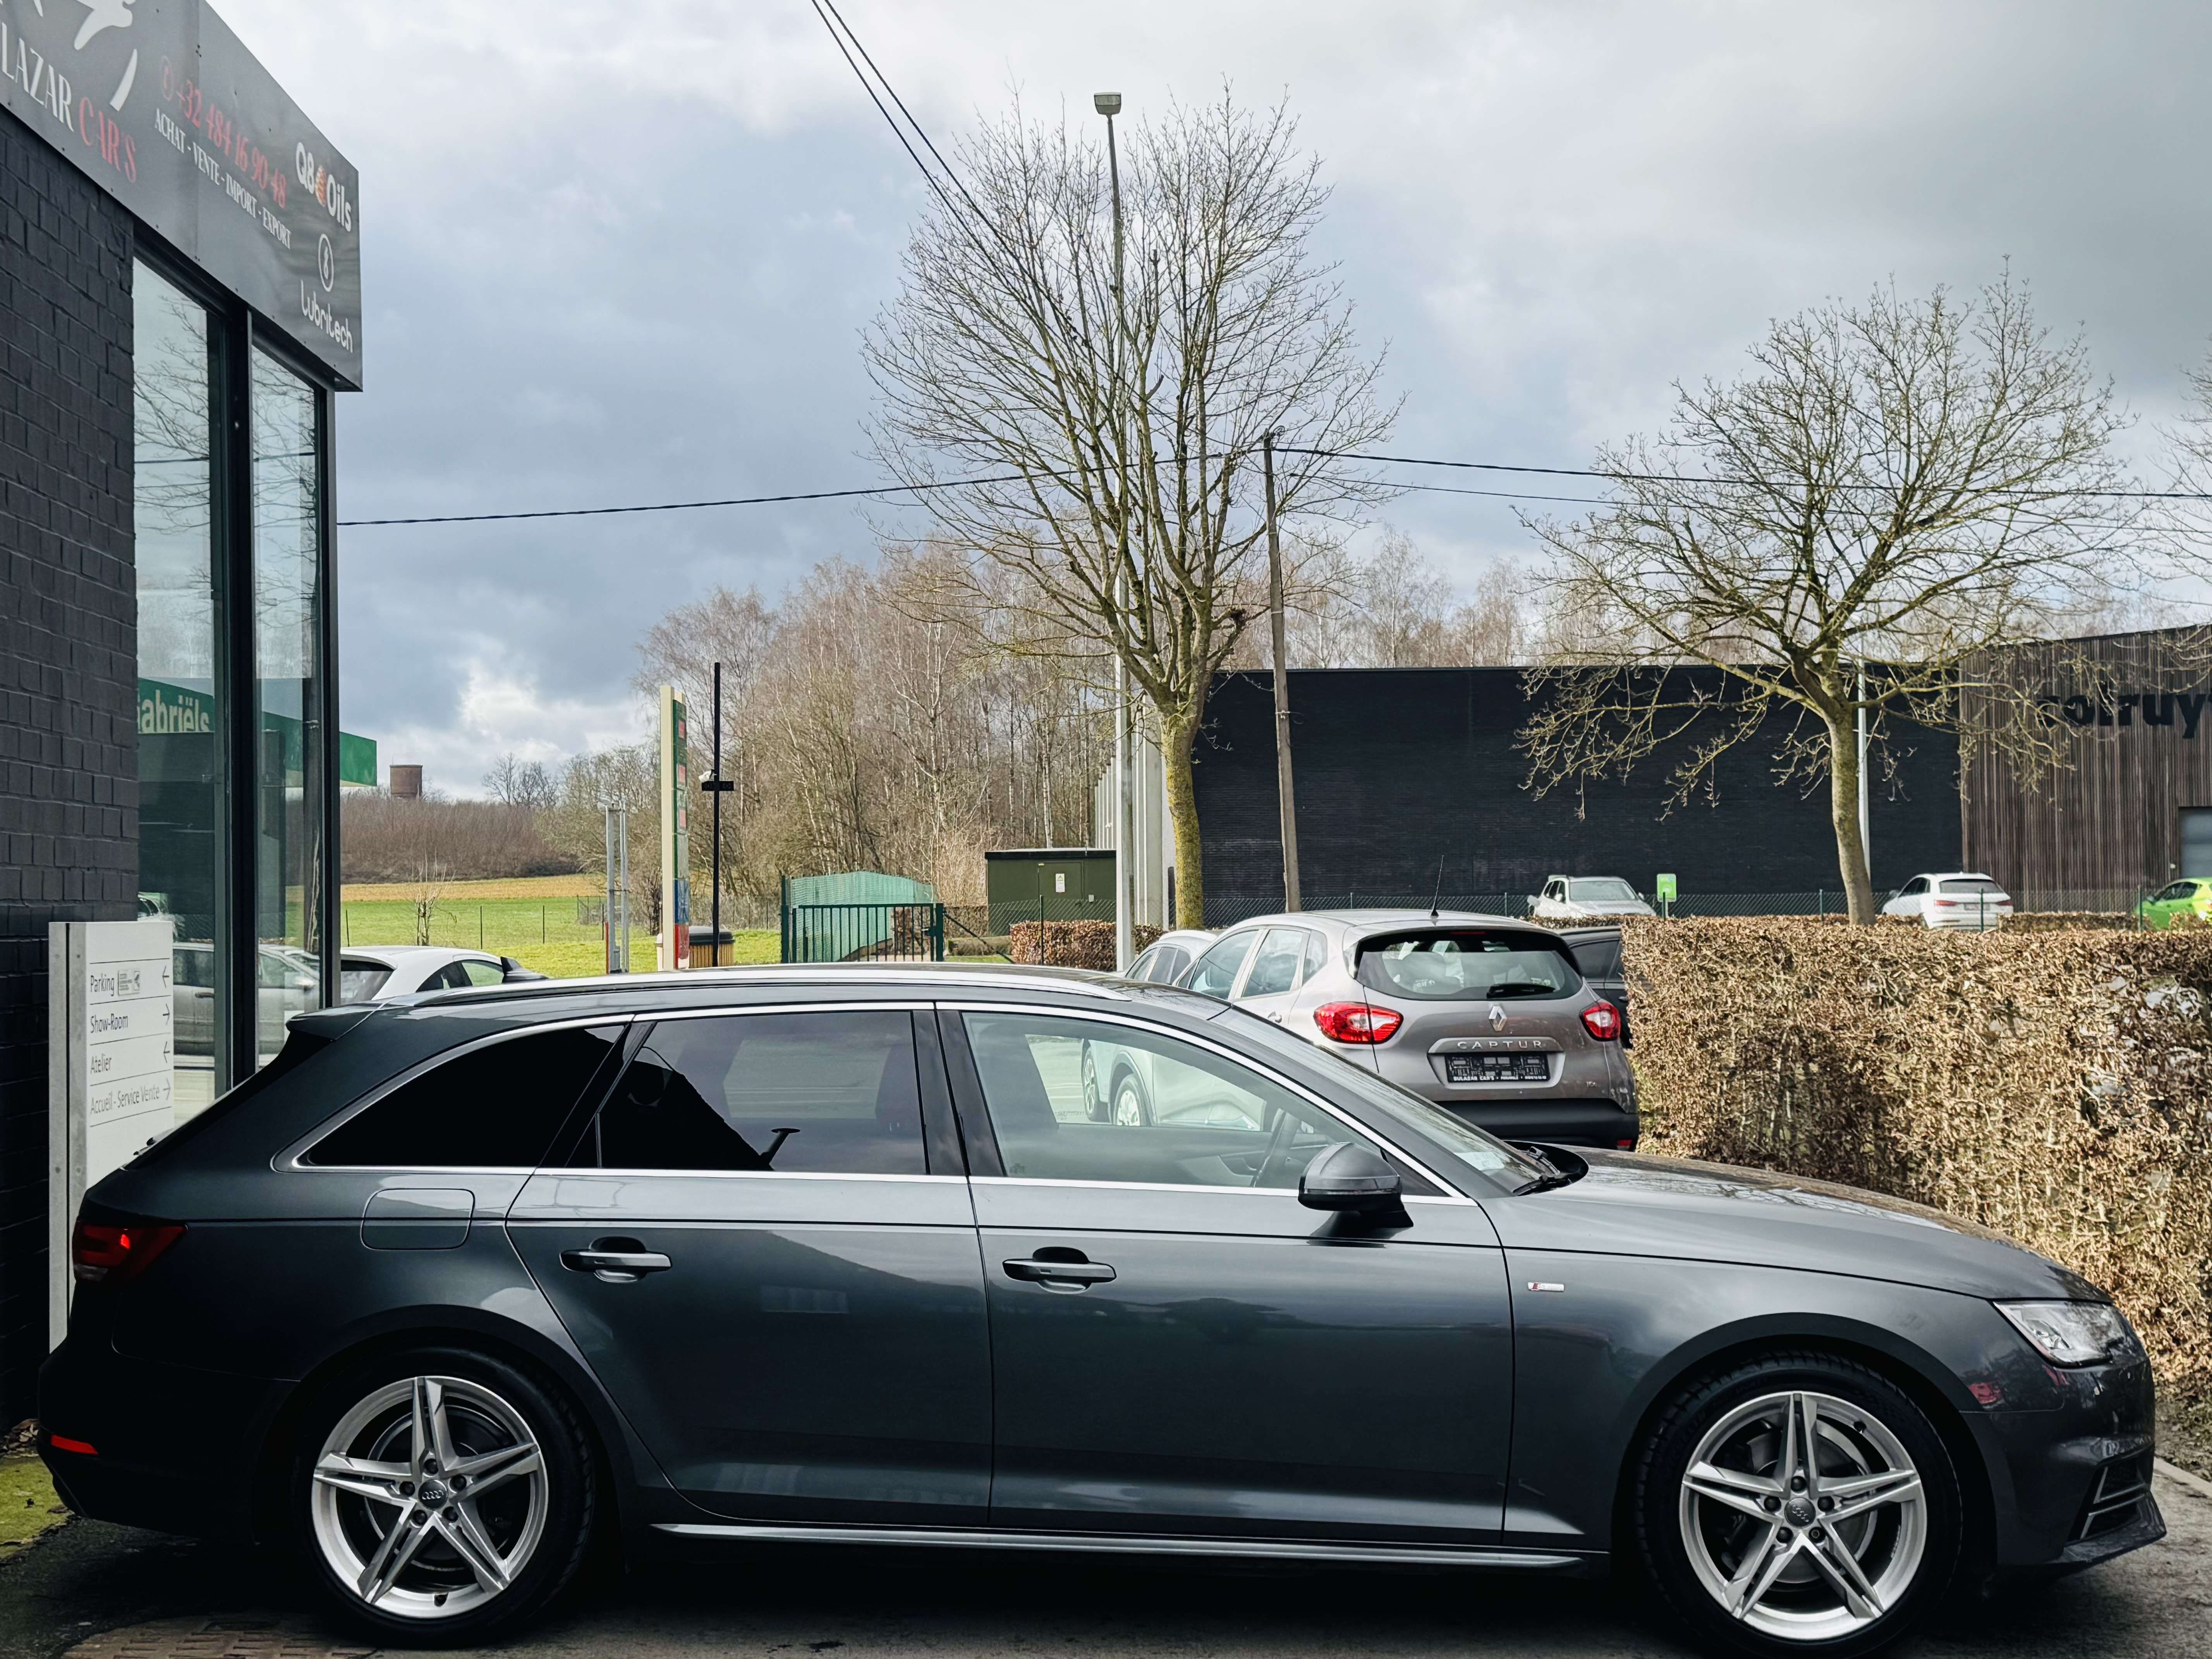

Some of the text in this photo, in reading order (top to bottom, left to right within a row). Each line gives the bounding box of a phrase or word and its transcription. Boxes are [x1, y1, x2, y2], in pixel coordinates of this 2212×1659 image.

[0, 21, 74, 132] LAZAR
[176, 79, 287, 209] +32 484 16 90 48
[155, 108, 186, 153] ACHAT
[192, 141, 221, 185] VENTE
[226, 173, 257, 218] IMPORT
[263, 207, 291, 249] EXPORT
[295, 142, 352, 232] Q8 Oils
[301, 279, 353, 354] Lubritech
[137, 689, 210, 733] abriëls
[90, 973, 115, 997] Parking
[90, 1013, 129, 1034] Show-Room
[1457, 1040, 1542, 1049] CAPTUR
[90, 1054, 112, 1075] Atelier
[90, 1091, 112, 1116] Accueil
[117, 1088, 139, 1108] Service
[140, 1084, 160, 1103] Vente
